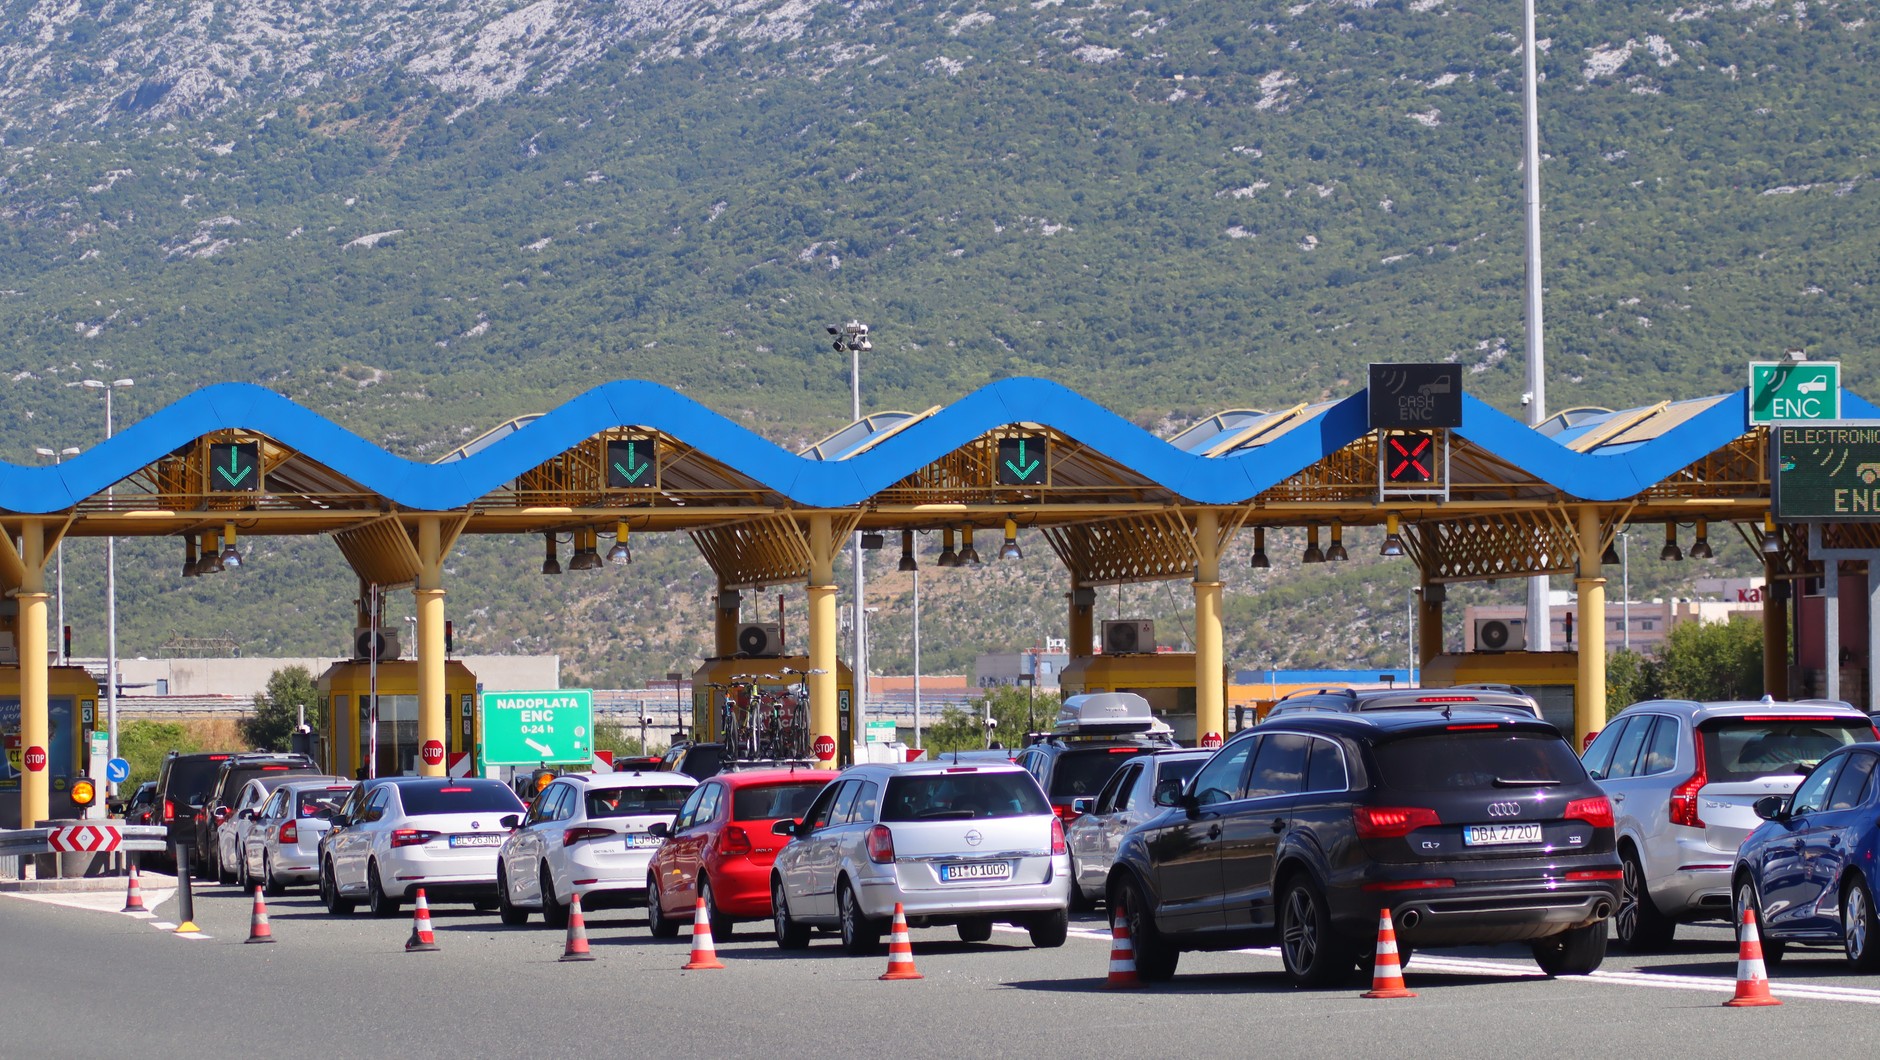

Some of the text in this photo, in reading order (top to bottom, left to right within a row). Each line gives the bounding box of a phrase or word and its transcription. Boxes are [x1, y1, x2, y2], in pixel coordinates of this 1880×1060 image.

[1398, 395, 1435, 409] CASH
[1773, 397, 1821, 418] ENC
[1400, 407, 1433, 421] ENC
[463, 702, 471, 715] 4
[496, 697, 579, 709] NADOPLATA
[840, 697, 848, 710] 5
[83, 708, 92, 722] 3
[521, 710, 554, 722] ENC
[521, 724, 554, 734] 0-24 h
[815, 743, 834, 753] STOP
[1203, 739, 1221, 748] STOP
[423, 747, 443, 758] STOP
[26, 754, 45, 764] STOP
[1471, 824, 1540, 842] DBA 27207
